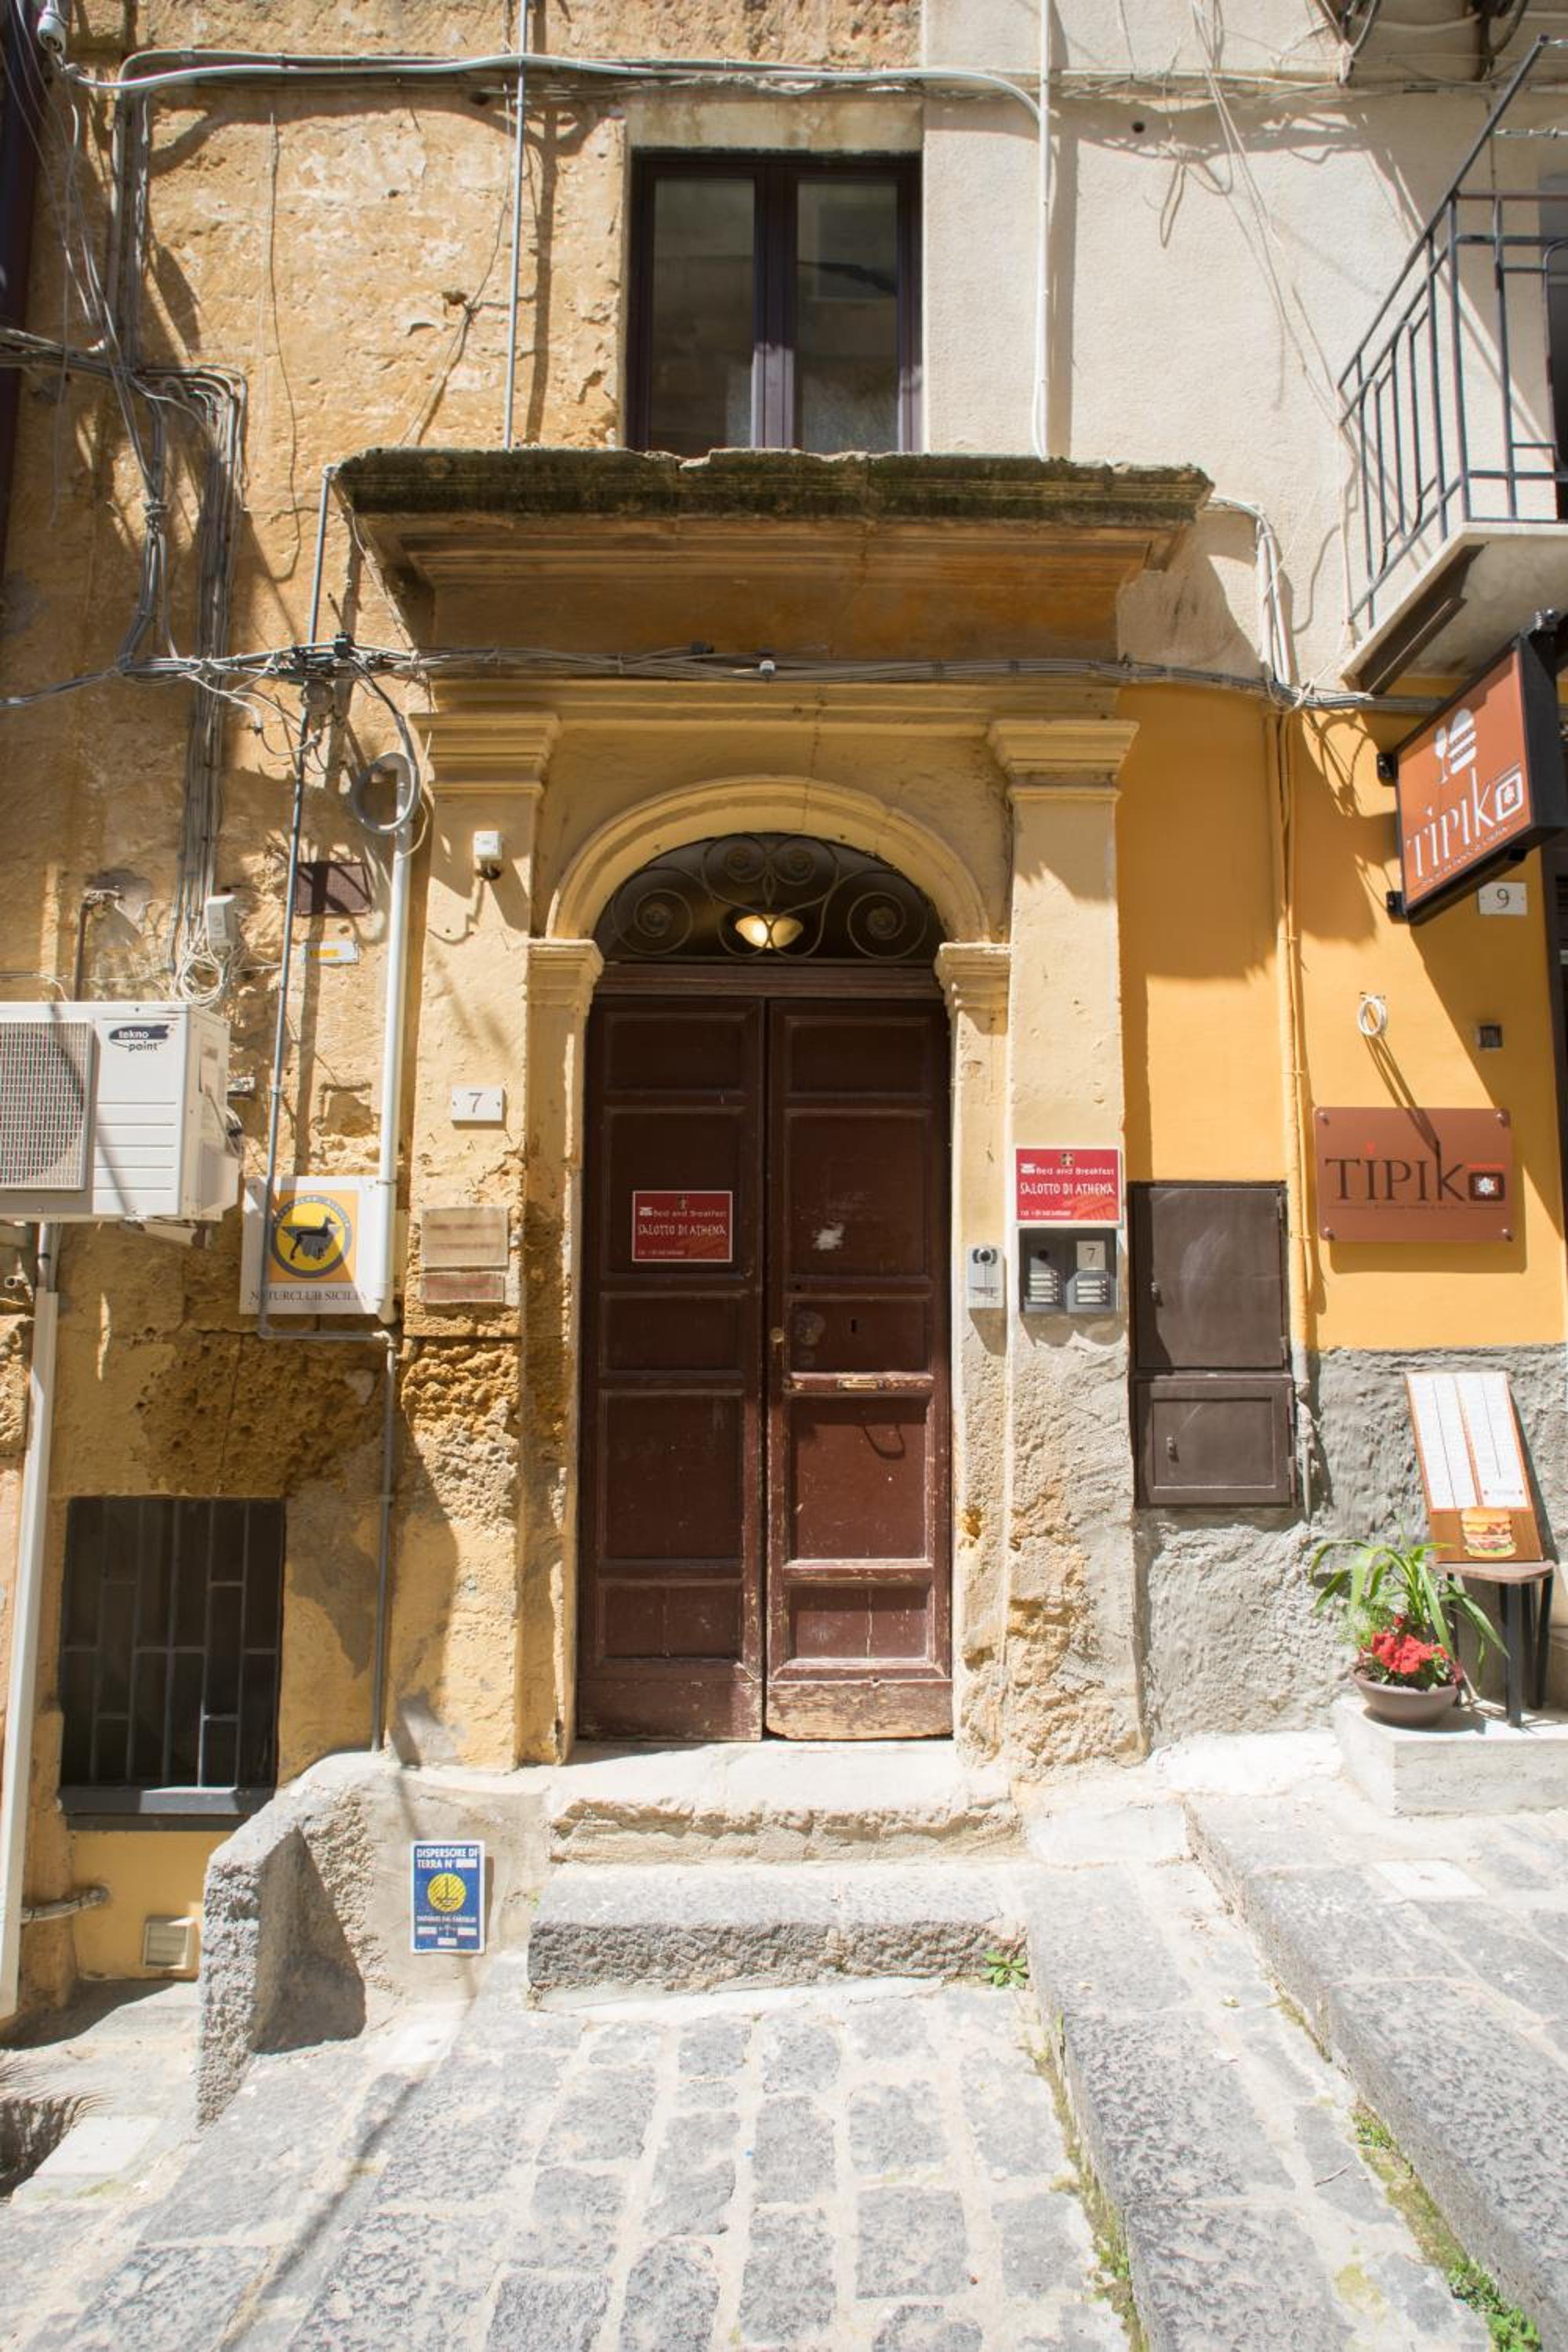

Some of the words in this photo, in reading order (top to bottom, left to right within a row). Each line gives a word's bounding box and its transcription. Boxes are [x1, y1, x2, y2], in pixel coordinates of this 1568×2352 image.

[1496, 887, 1510, 909] 9
[118, 1029, 150, 1039] tekno
[128, 1040, 158, 1052] point
[468, 1092, 484, 1113] 7
[1020, 1181, 1061, 1195] SALOTTO
[1062, 1183, 1073, 1195] DI
[1075, 1183, 1116, 1196] ATHENA
[638, 1224, 676, 1236] SALOTTO
[677, 1224, 688, 1236] DI
[689, 1224, 728, 1237] ATHENA
[1085, 1247, 1097, 1262] 7
[250, 1290, 323, 1301] NTURCLUB
[416, 1848, 466, 1857] DISPERSORE
[417, 1859, 443, 1869] TERRA
